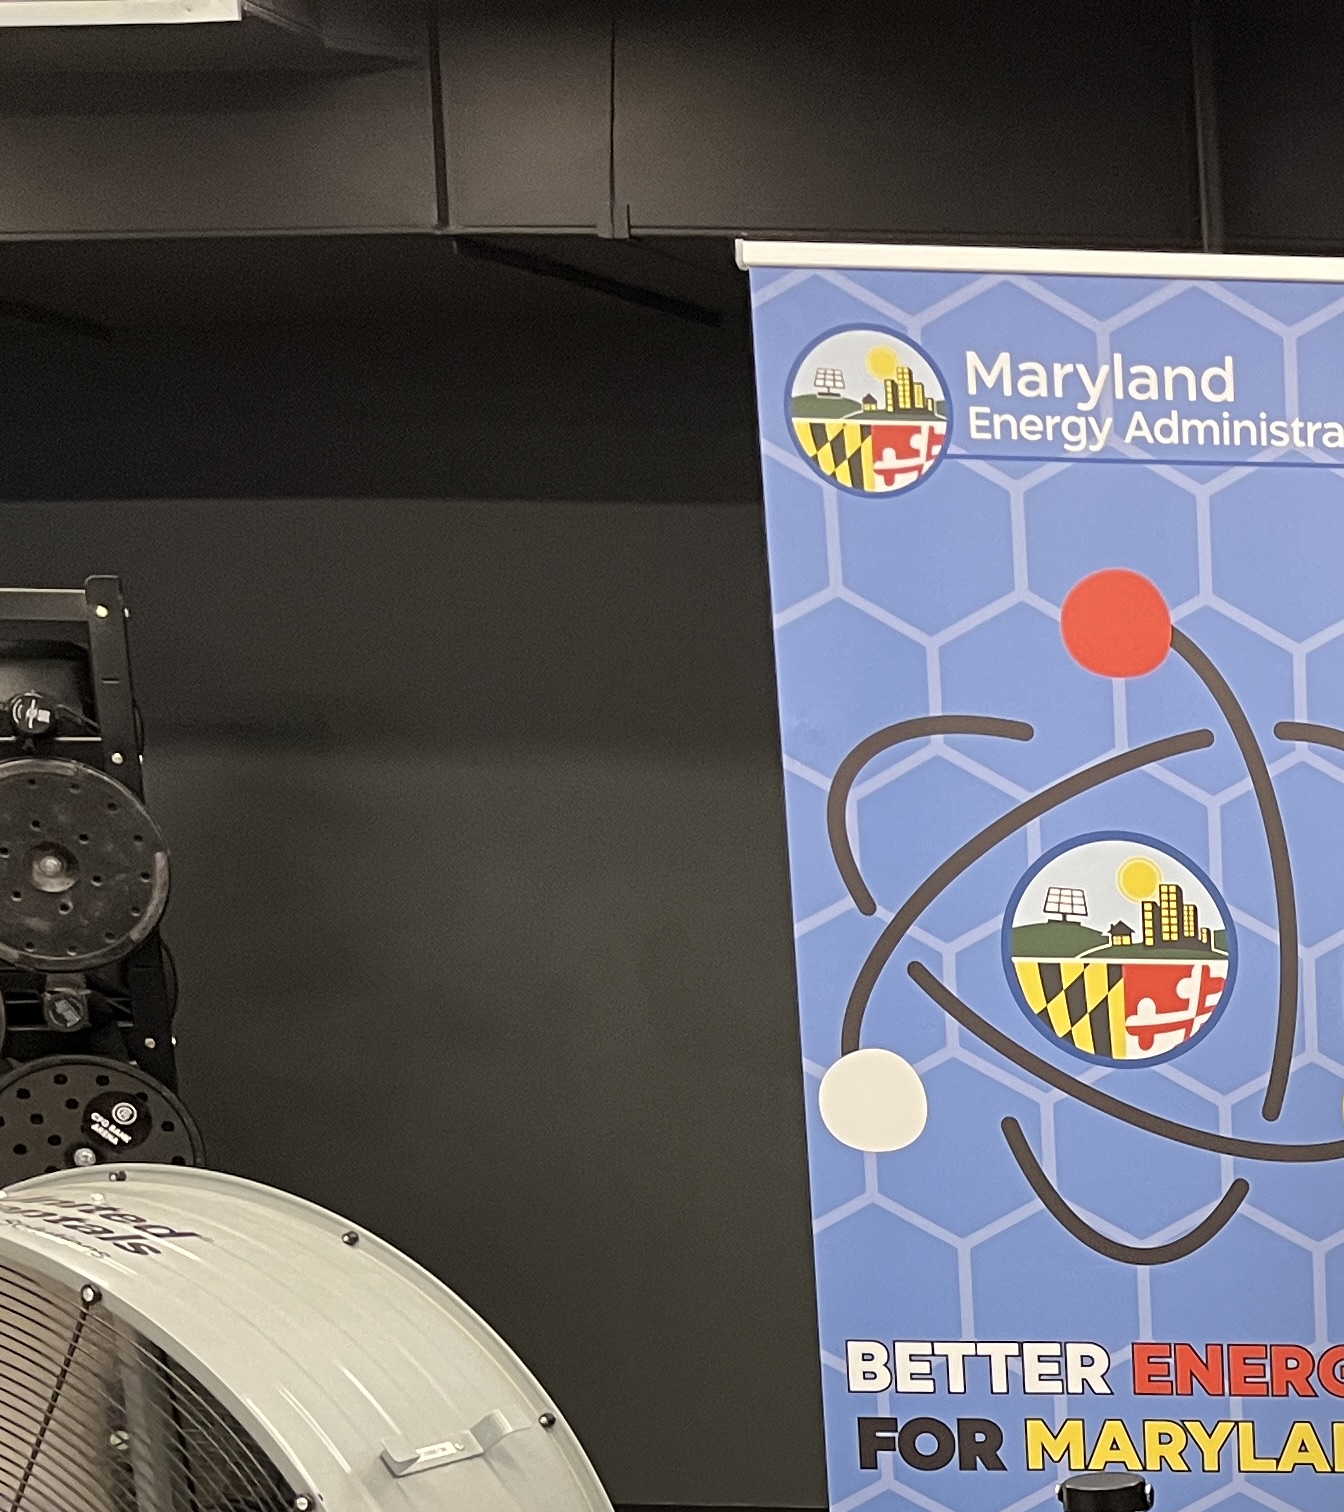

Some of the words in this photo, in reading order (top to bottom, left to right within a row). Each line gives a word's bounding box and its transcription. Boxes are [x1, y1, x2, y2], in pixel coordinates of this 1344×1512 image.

[965, 351, 1235, 411] Maryland
[968, 406, 1113, 452] Energy
[845, 1339, 1112, 1395] BETTER
[857, 1416, 1009, 1472] FOR
